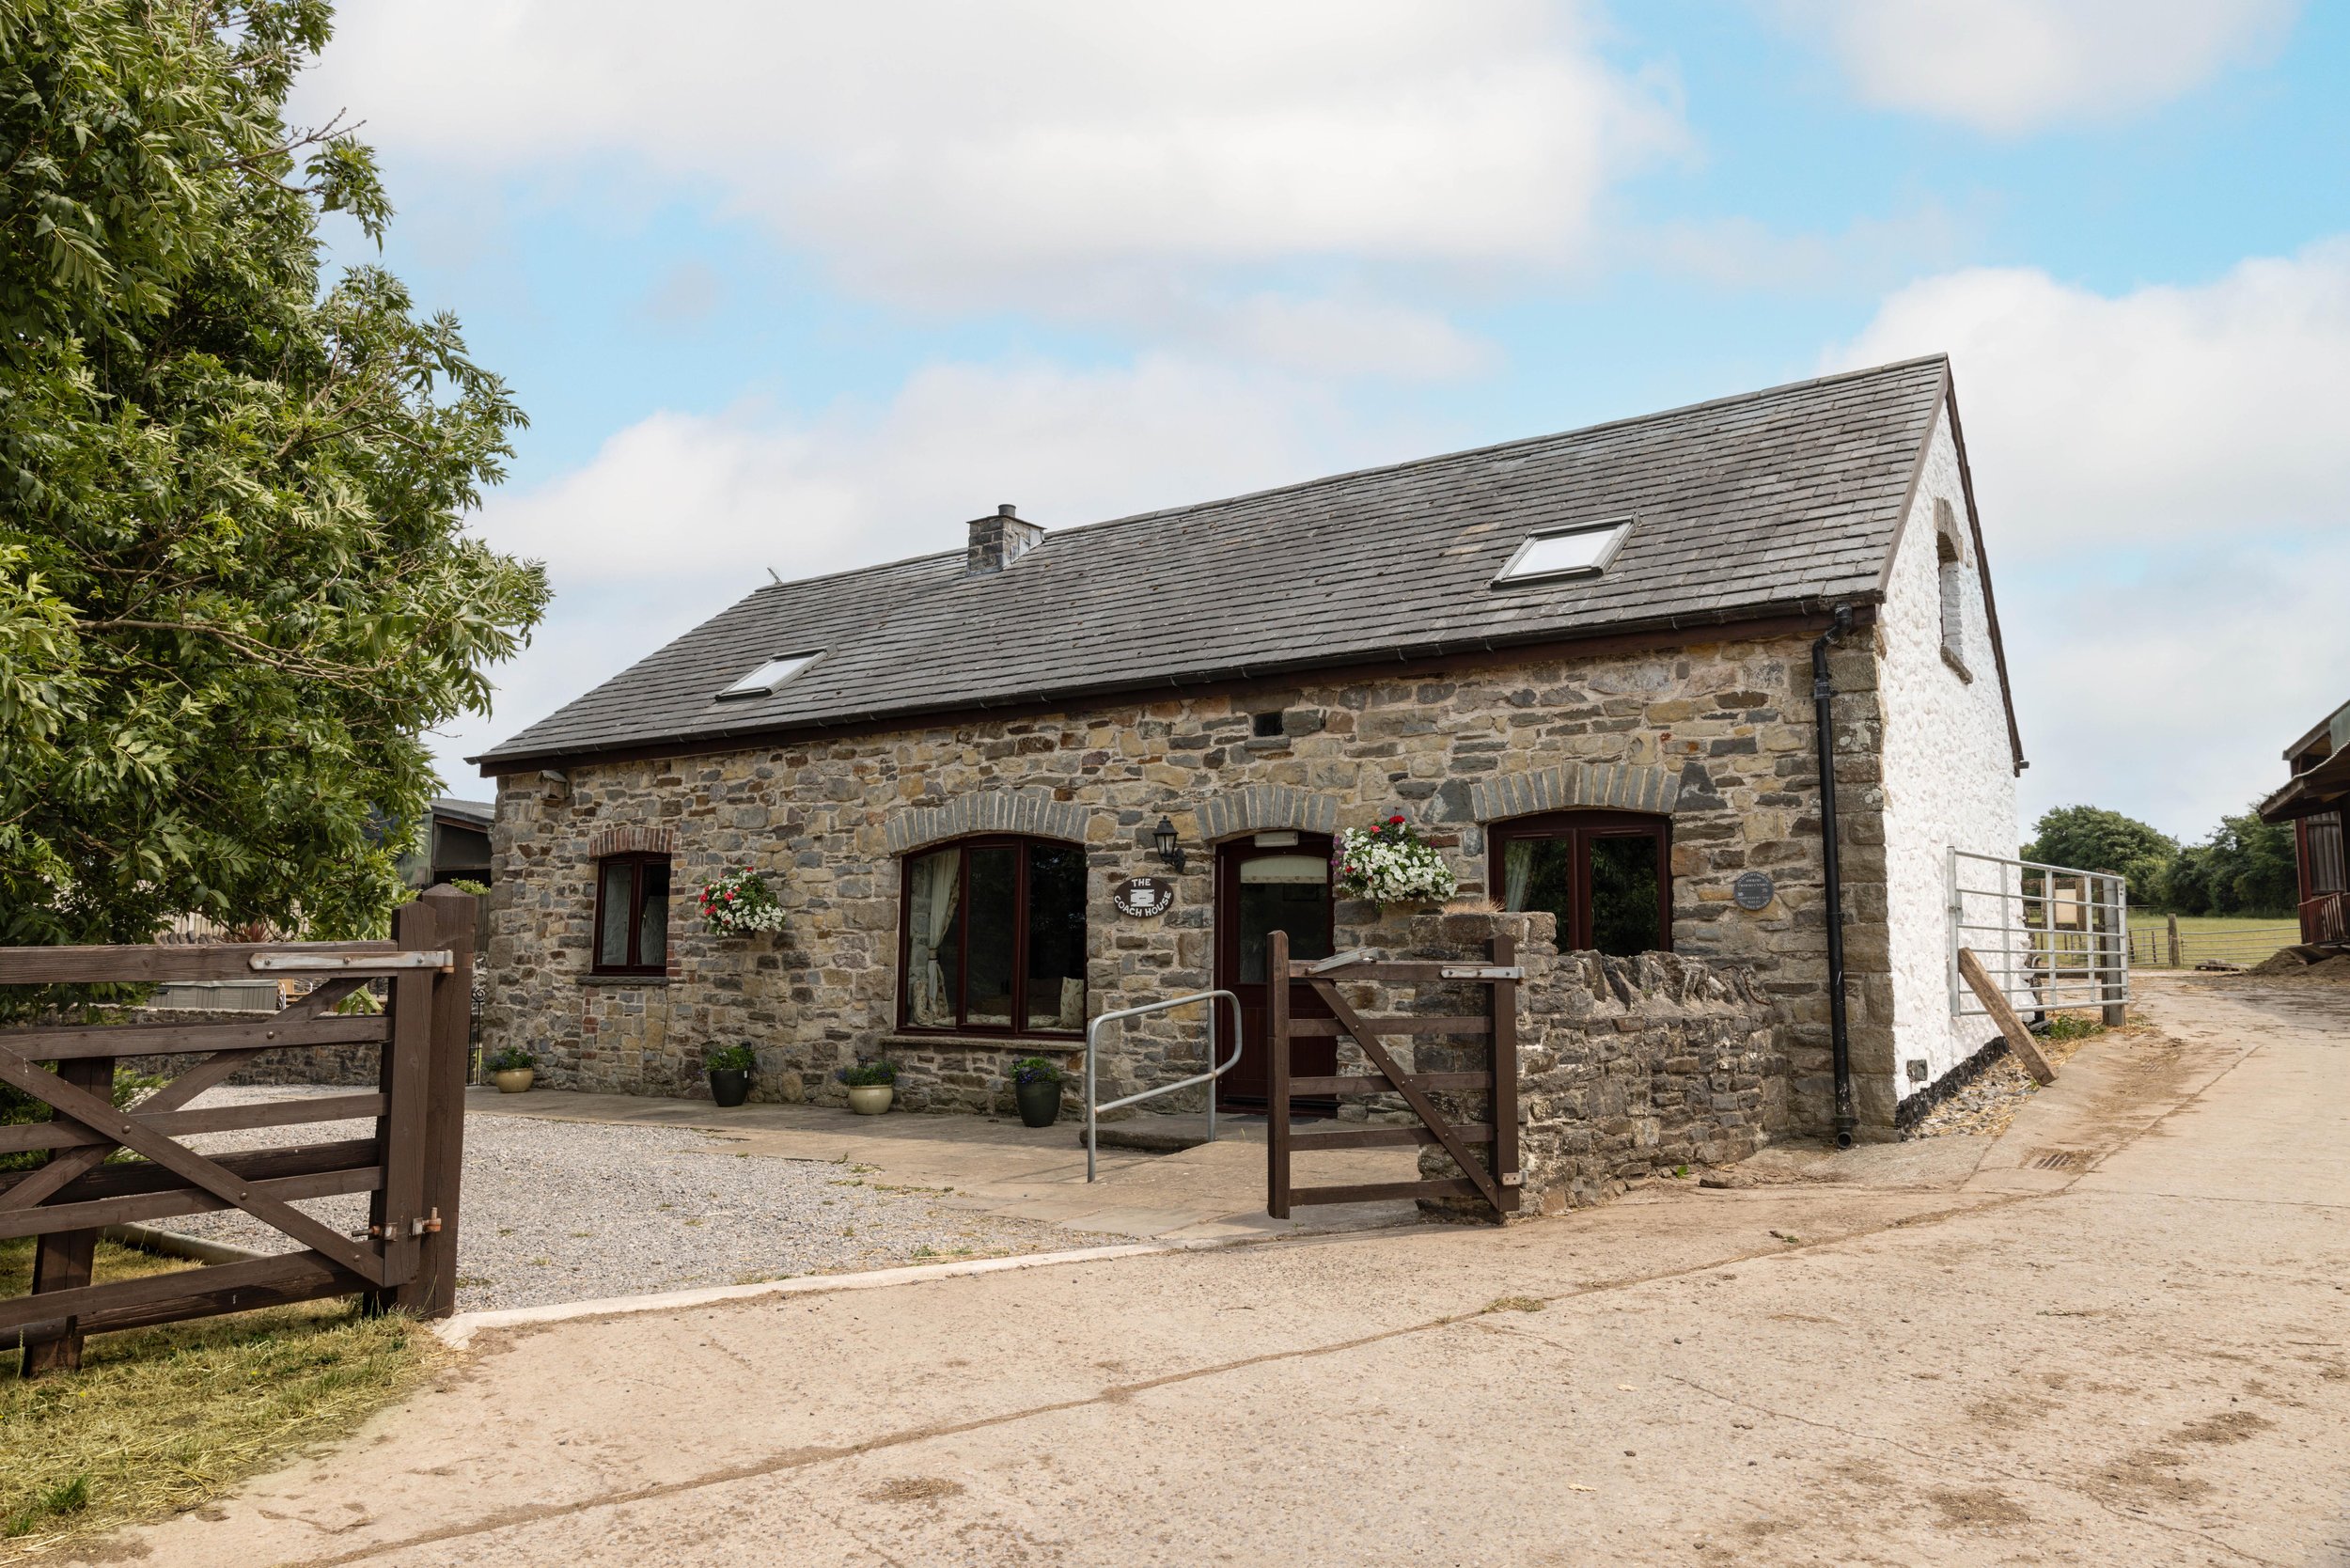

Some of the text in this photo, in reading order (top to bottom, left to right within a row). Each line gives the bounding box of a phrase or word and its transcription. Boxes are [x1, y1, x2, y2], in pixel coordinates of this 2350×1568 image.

[1131, 878, 1152, 887] THE
[1114, 890, 1172, 917] COACH HOUSE
